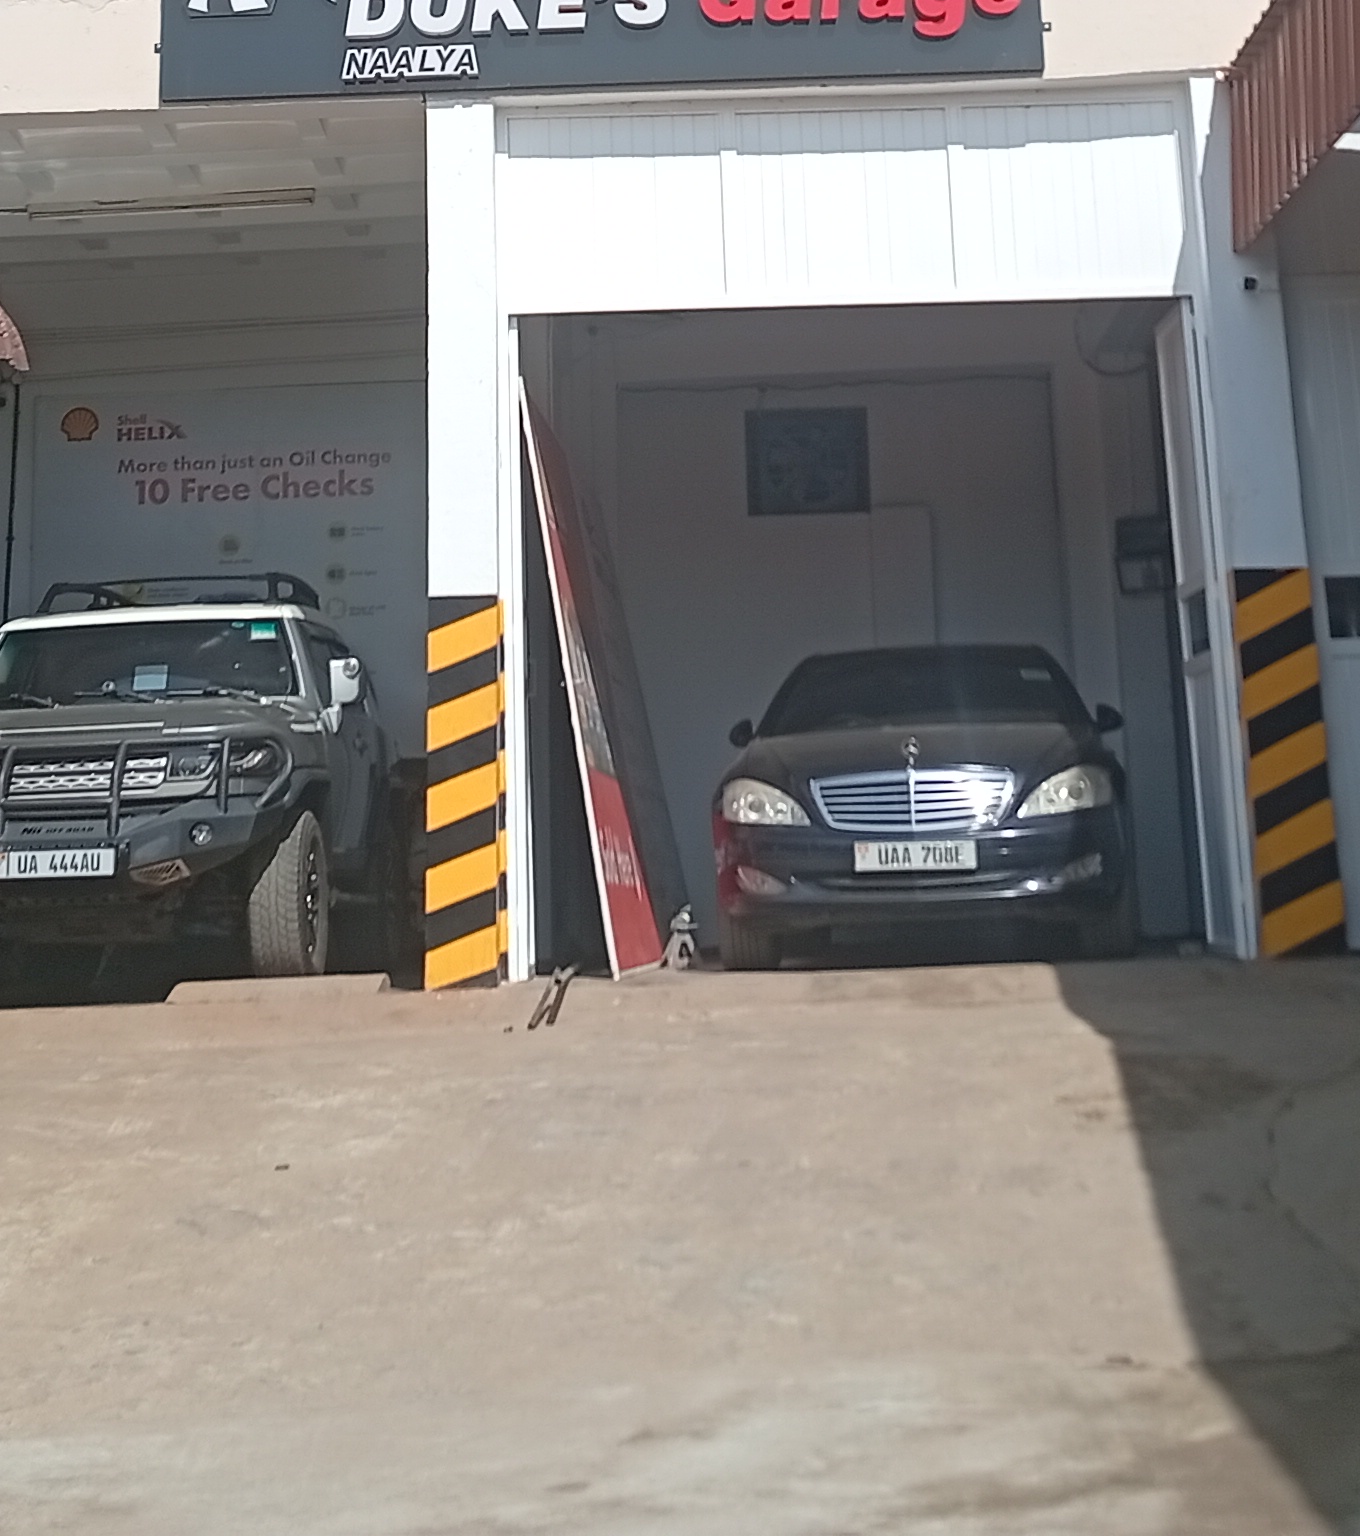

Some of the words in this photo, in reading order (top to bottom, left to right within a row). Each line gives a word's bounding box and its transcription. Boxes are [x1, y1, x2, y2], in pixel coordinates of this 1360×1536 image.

[342, 44, 480, 83] NAALYA
[116, 419, 187, 442] HELIX
[117, 415, 148, 427] Shell
[117, 458, 168, 474] More
[173, 456, 216, 472] than
[219, 454, 255, 474] just
[259, 456, 284, 468] an
[288, 451, 316, 466] Oil
[321, 449, 392, 467] Change
[135, 478, 171, 506] 10
[180, 477, 251, 503] Free
[260, 470, 375, 501] Checks
[17, 854, 38, 874] UA
[48, 852, 100, 873] 444AU
[878, 844, 911, 865] UAA
